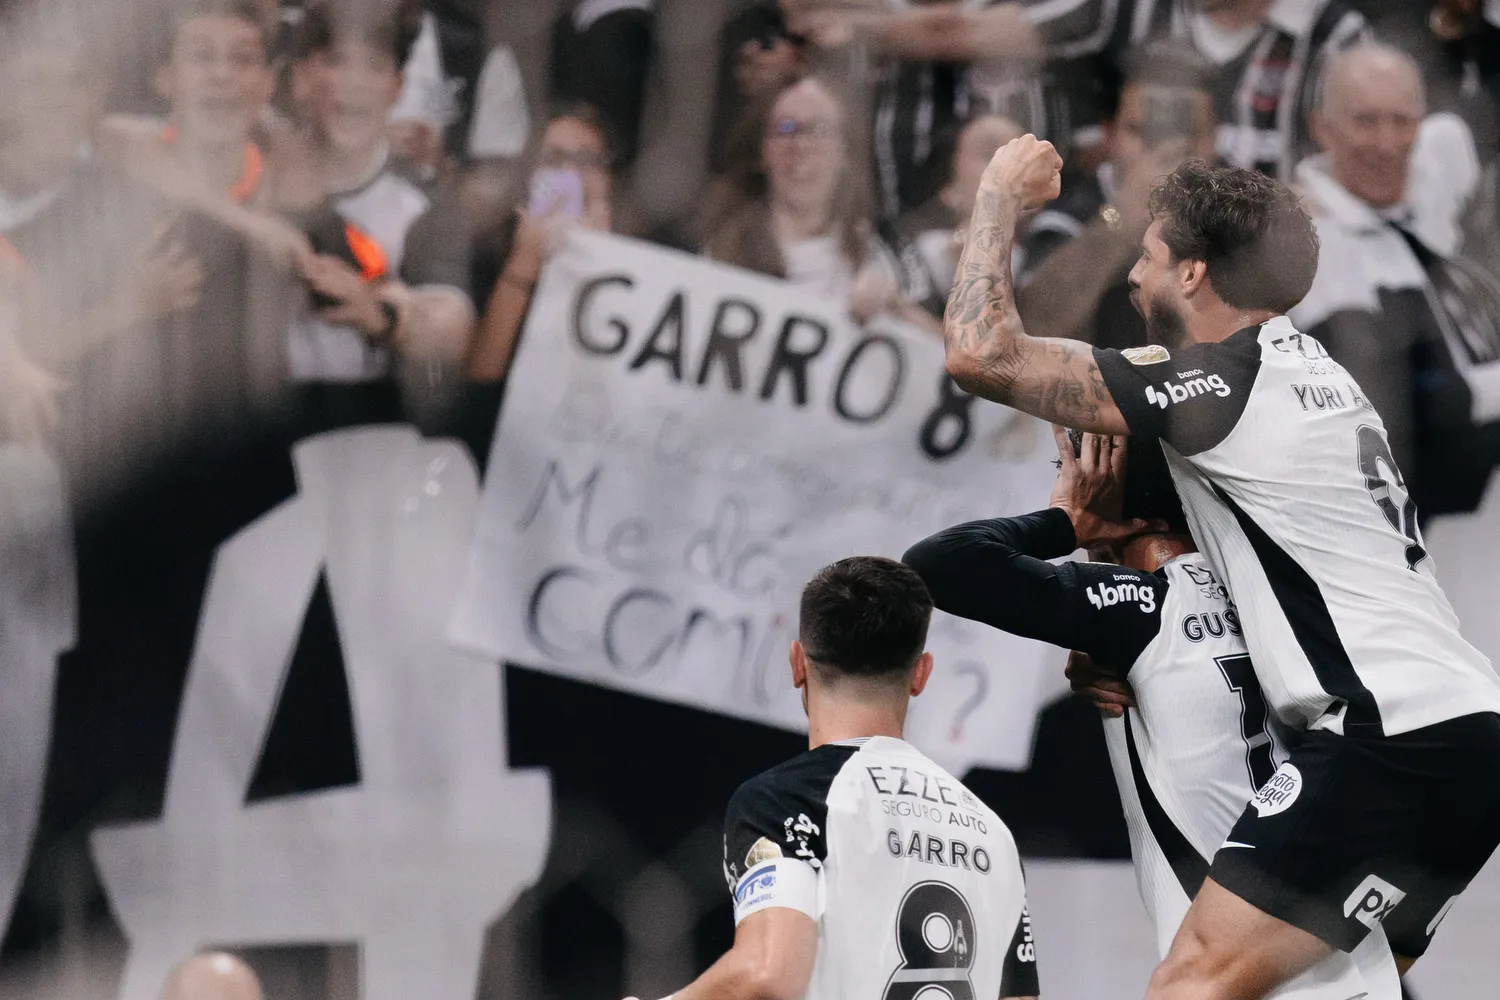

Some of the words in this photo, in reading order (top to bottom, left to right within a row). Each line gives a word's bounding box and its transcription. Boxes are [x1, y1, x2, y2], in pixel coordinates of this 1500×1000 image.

[570, 266, 908, 425] GARRO
[1165, 372, 1231, 405] bmg
[1176, 367, 1204, 380] banco
[1290, 383, 1347, 412] YURI
[1112, 573, 1141, 583] banco
[1100, 583, 1156, 614] bmg
[866, 765, 958, 807] EZZE
[881, 799, 943, 824] SEGURO
[948, 811, 988, 835] AUTO
[887, 827, 992, 876] GARRO
[1351, 886, 1396, 922] px
